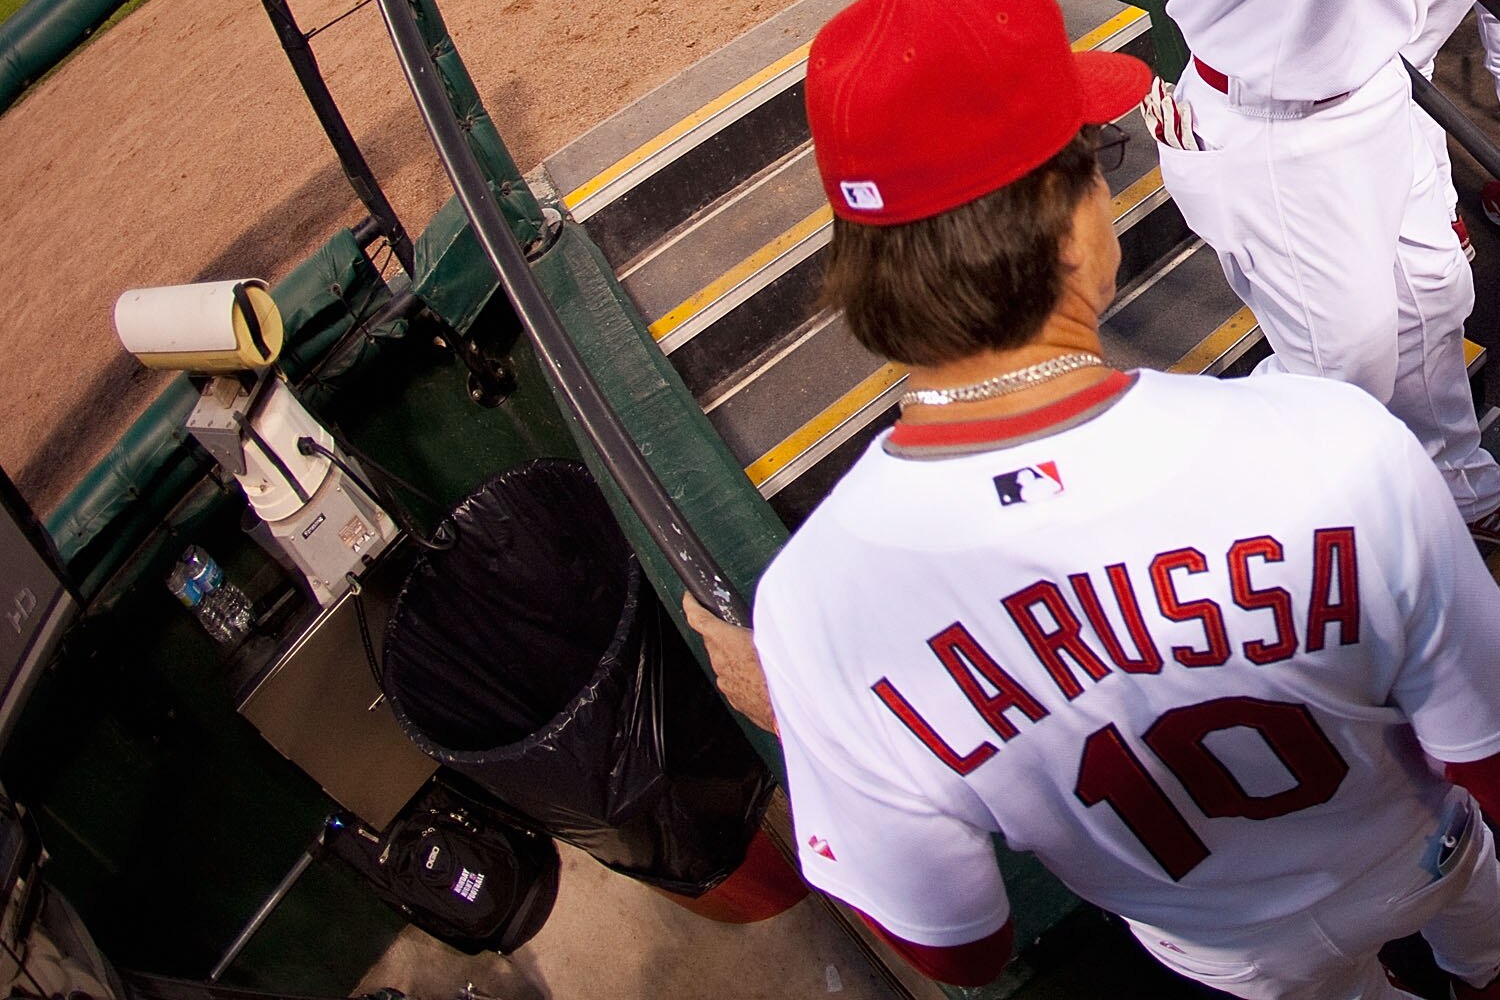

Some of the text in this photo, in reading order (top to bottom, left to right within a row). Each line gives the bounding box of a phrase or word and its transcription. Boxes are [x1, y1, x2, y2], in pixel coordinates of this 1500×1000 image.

[1075, 694, 1350, 882] 10
[425, 846, 440, 869] OGIO
[454, 867, 470, 894] MONDAY
[460, 880, 474, 898] NIGHT
[466, 873, 485, 902] FOOTBALL
